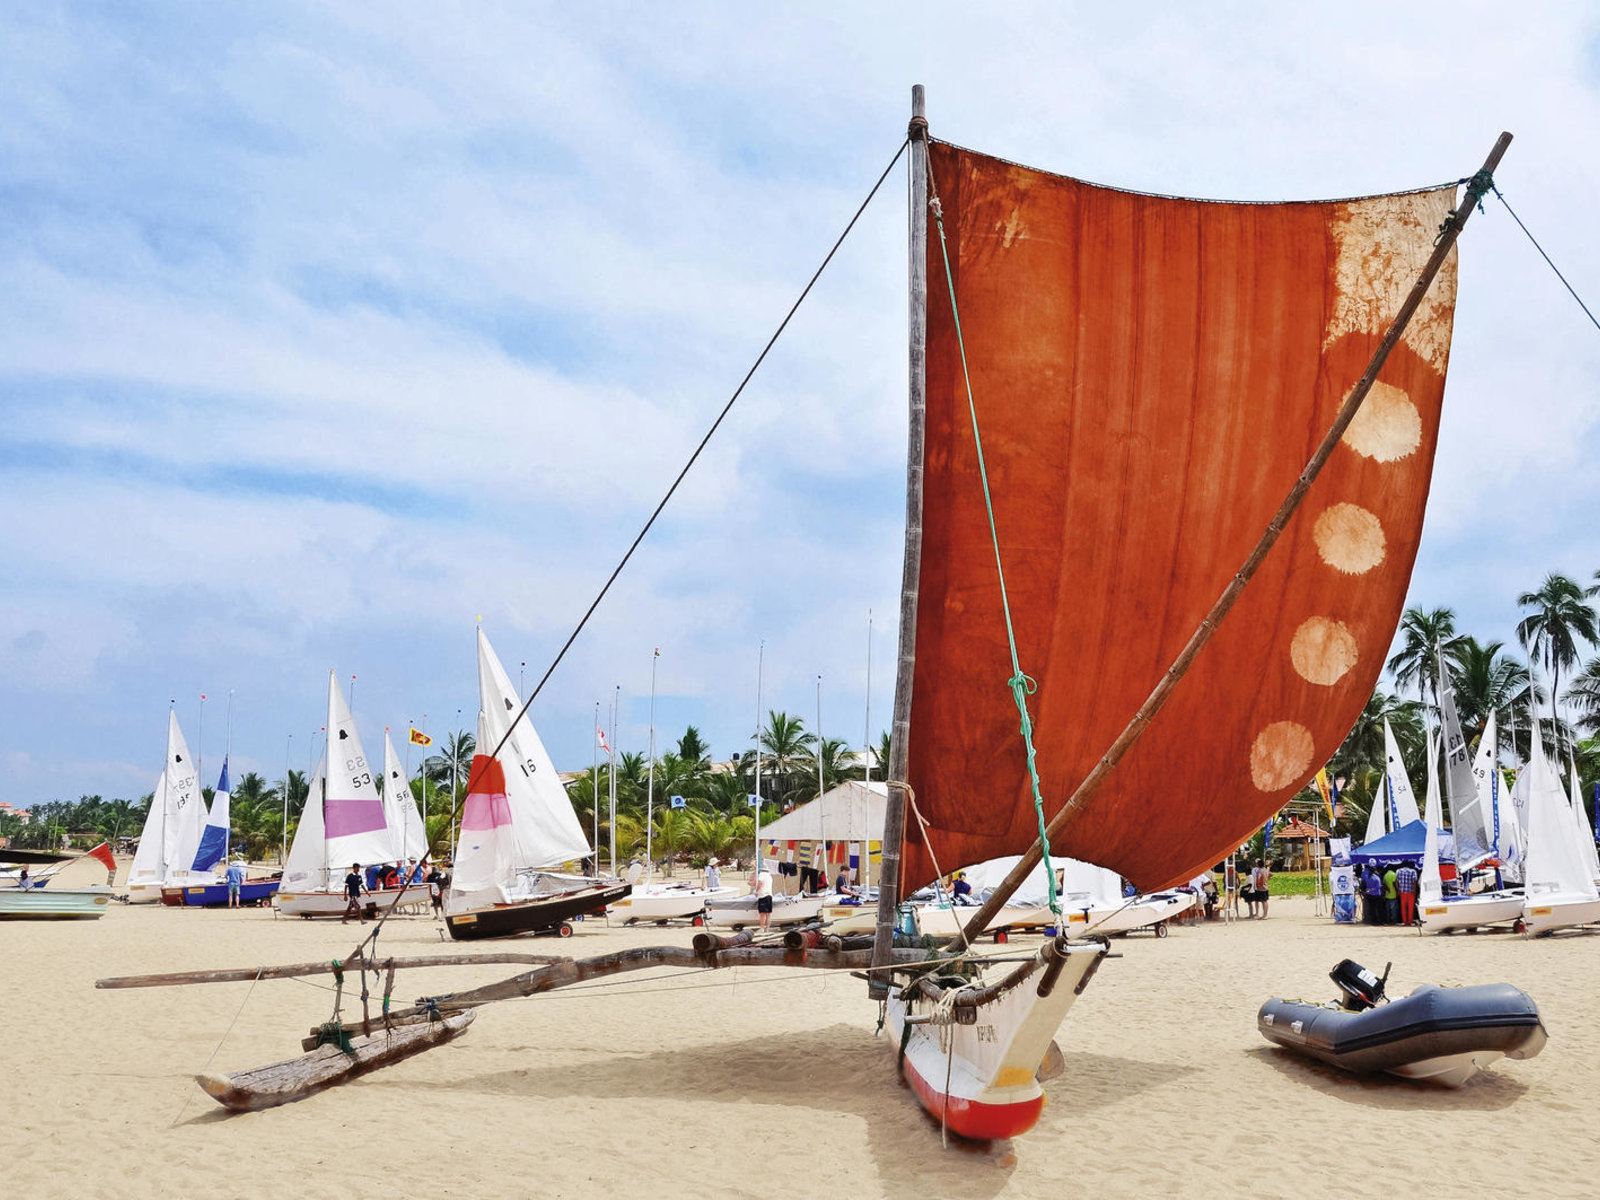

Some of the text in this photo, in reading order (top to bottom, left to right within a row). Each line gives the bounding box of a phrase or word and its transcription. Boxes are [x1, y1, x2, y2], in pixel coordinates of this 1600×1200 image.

[520, 758, 537, 777] 16
[1473, 767, 1485, 778] 49
[352, 773, 371, 788] 53
